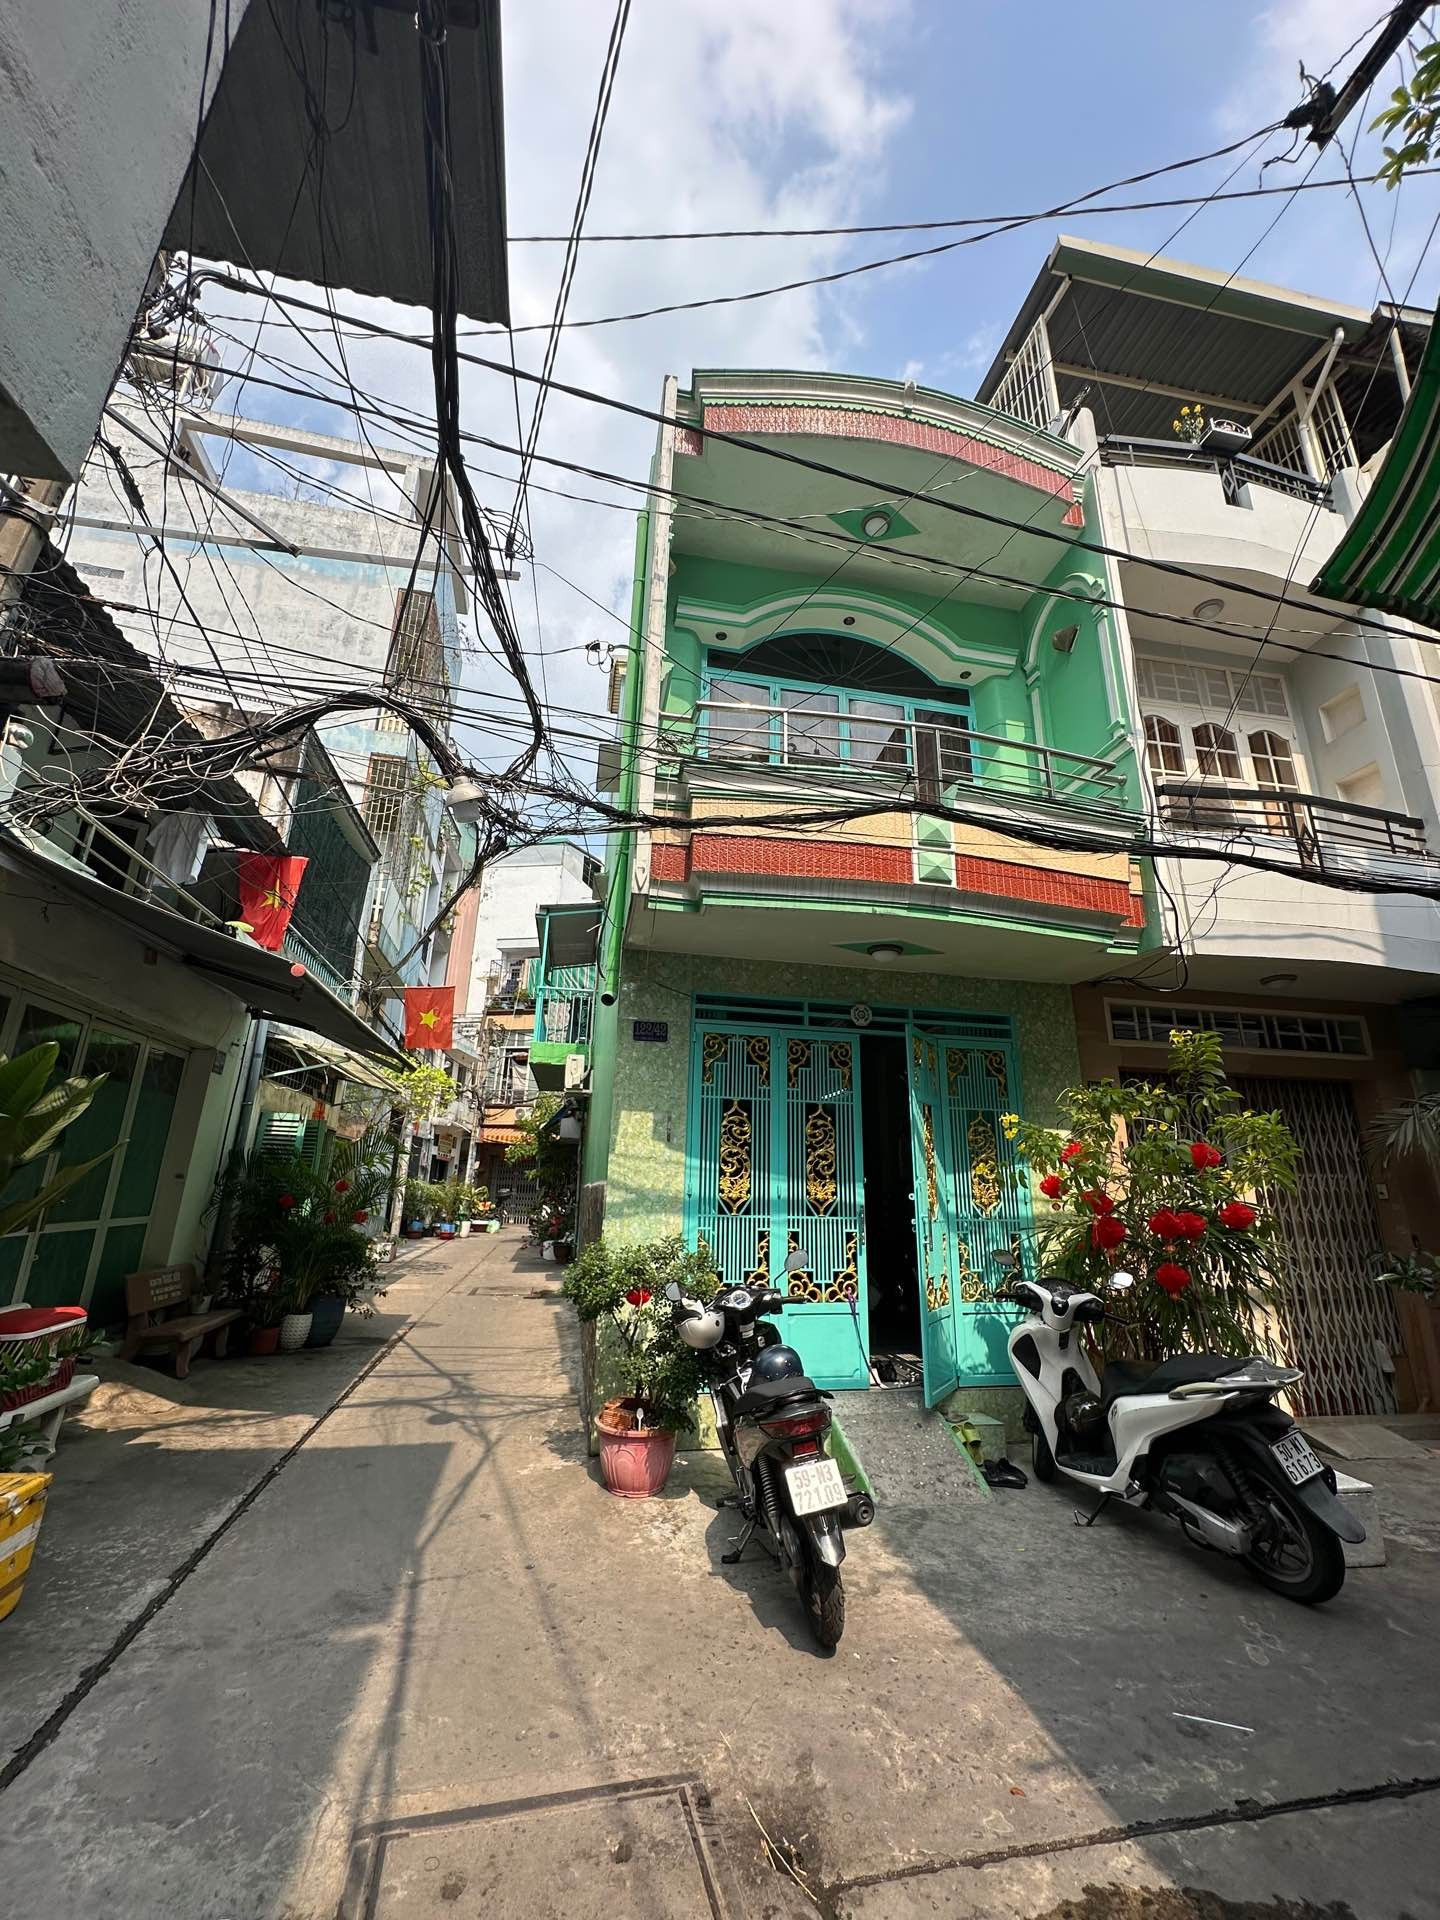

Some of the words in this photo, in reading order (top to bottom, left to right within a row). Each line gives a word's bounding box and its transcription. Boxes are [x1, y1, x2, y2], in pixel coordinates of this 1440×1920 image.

[793, 1464, 833, 1489] 59-N3
[1286, 1452, 1320, 1481] 616.73
[794, 1482, 843, 1512] 721.09
